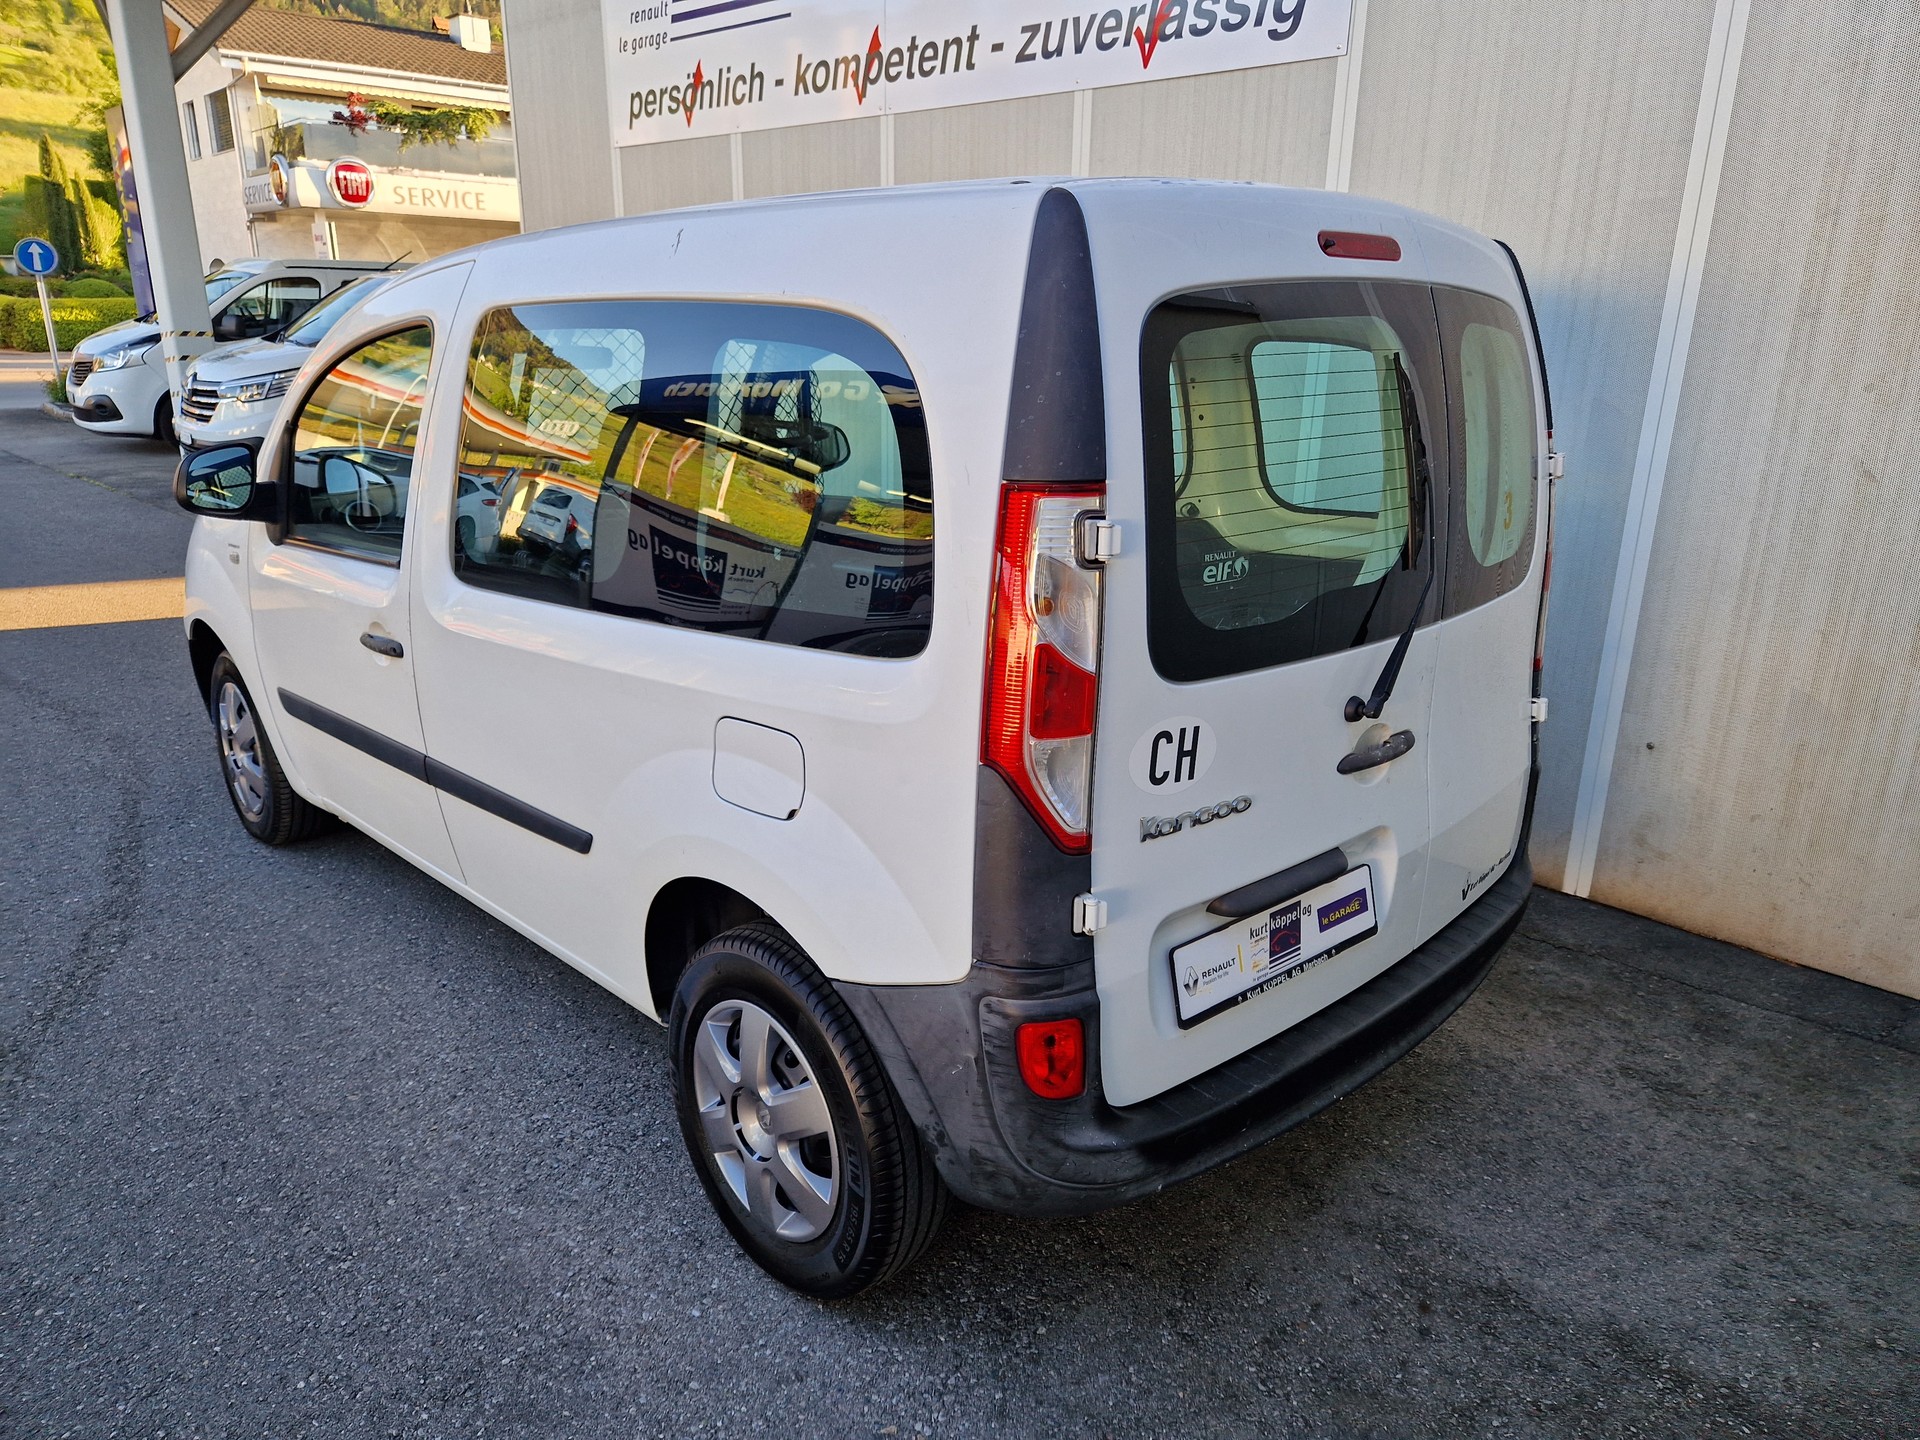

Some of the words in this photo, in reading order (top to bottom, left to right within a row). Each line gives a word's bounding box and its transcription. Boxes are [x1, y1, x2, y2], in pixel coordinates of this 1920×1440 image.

[630, 3, 669, 24] renault
[619, 37, 629, 53] le
[632, 31, 668, 55] garage
[629, 62, 765, 129] persönlich
[794, 24, 980, 99] kompetent
[243, 183, 273, 205] SERVICE
[338, 170, 370, 197] FIAT
[393, 186, 486, 211] SERVICE
[1204, 550, 1236, 563] RENAULT
[1202, 560, 1233, 583] elf
[1148, 725, 1200, 786] CH
[1139, 795, 1253, 843] Kangoo
[1249, 922, 1268, 940] kurt
[1270, 906, 1300, 931] köppel
[1302, 904, 1312, 917] ag
[1322, 917, 1329, 926] le
[1329, 902, 1361, 922] GARAGE
[1201, 957, 1237, 980] RENAULT
[1291, 966, 1302, 978] AG
